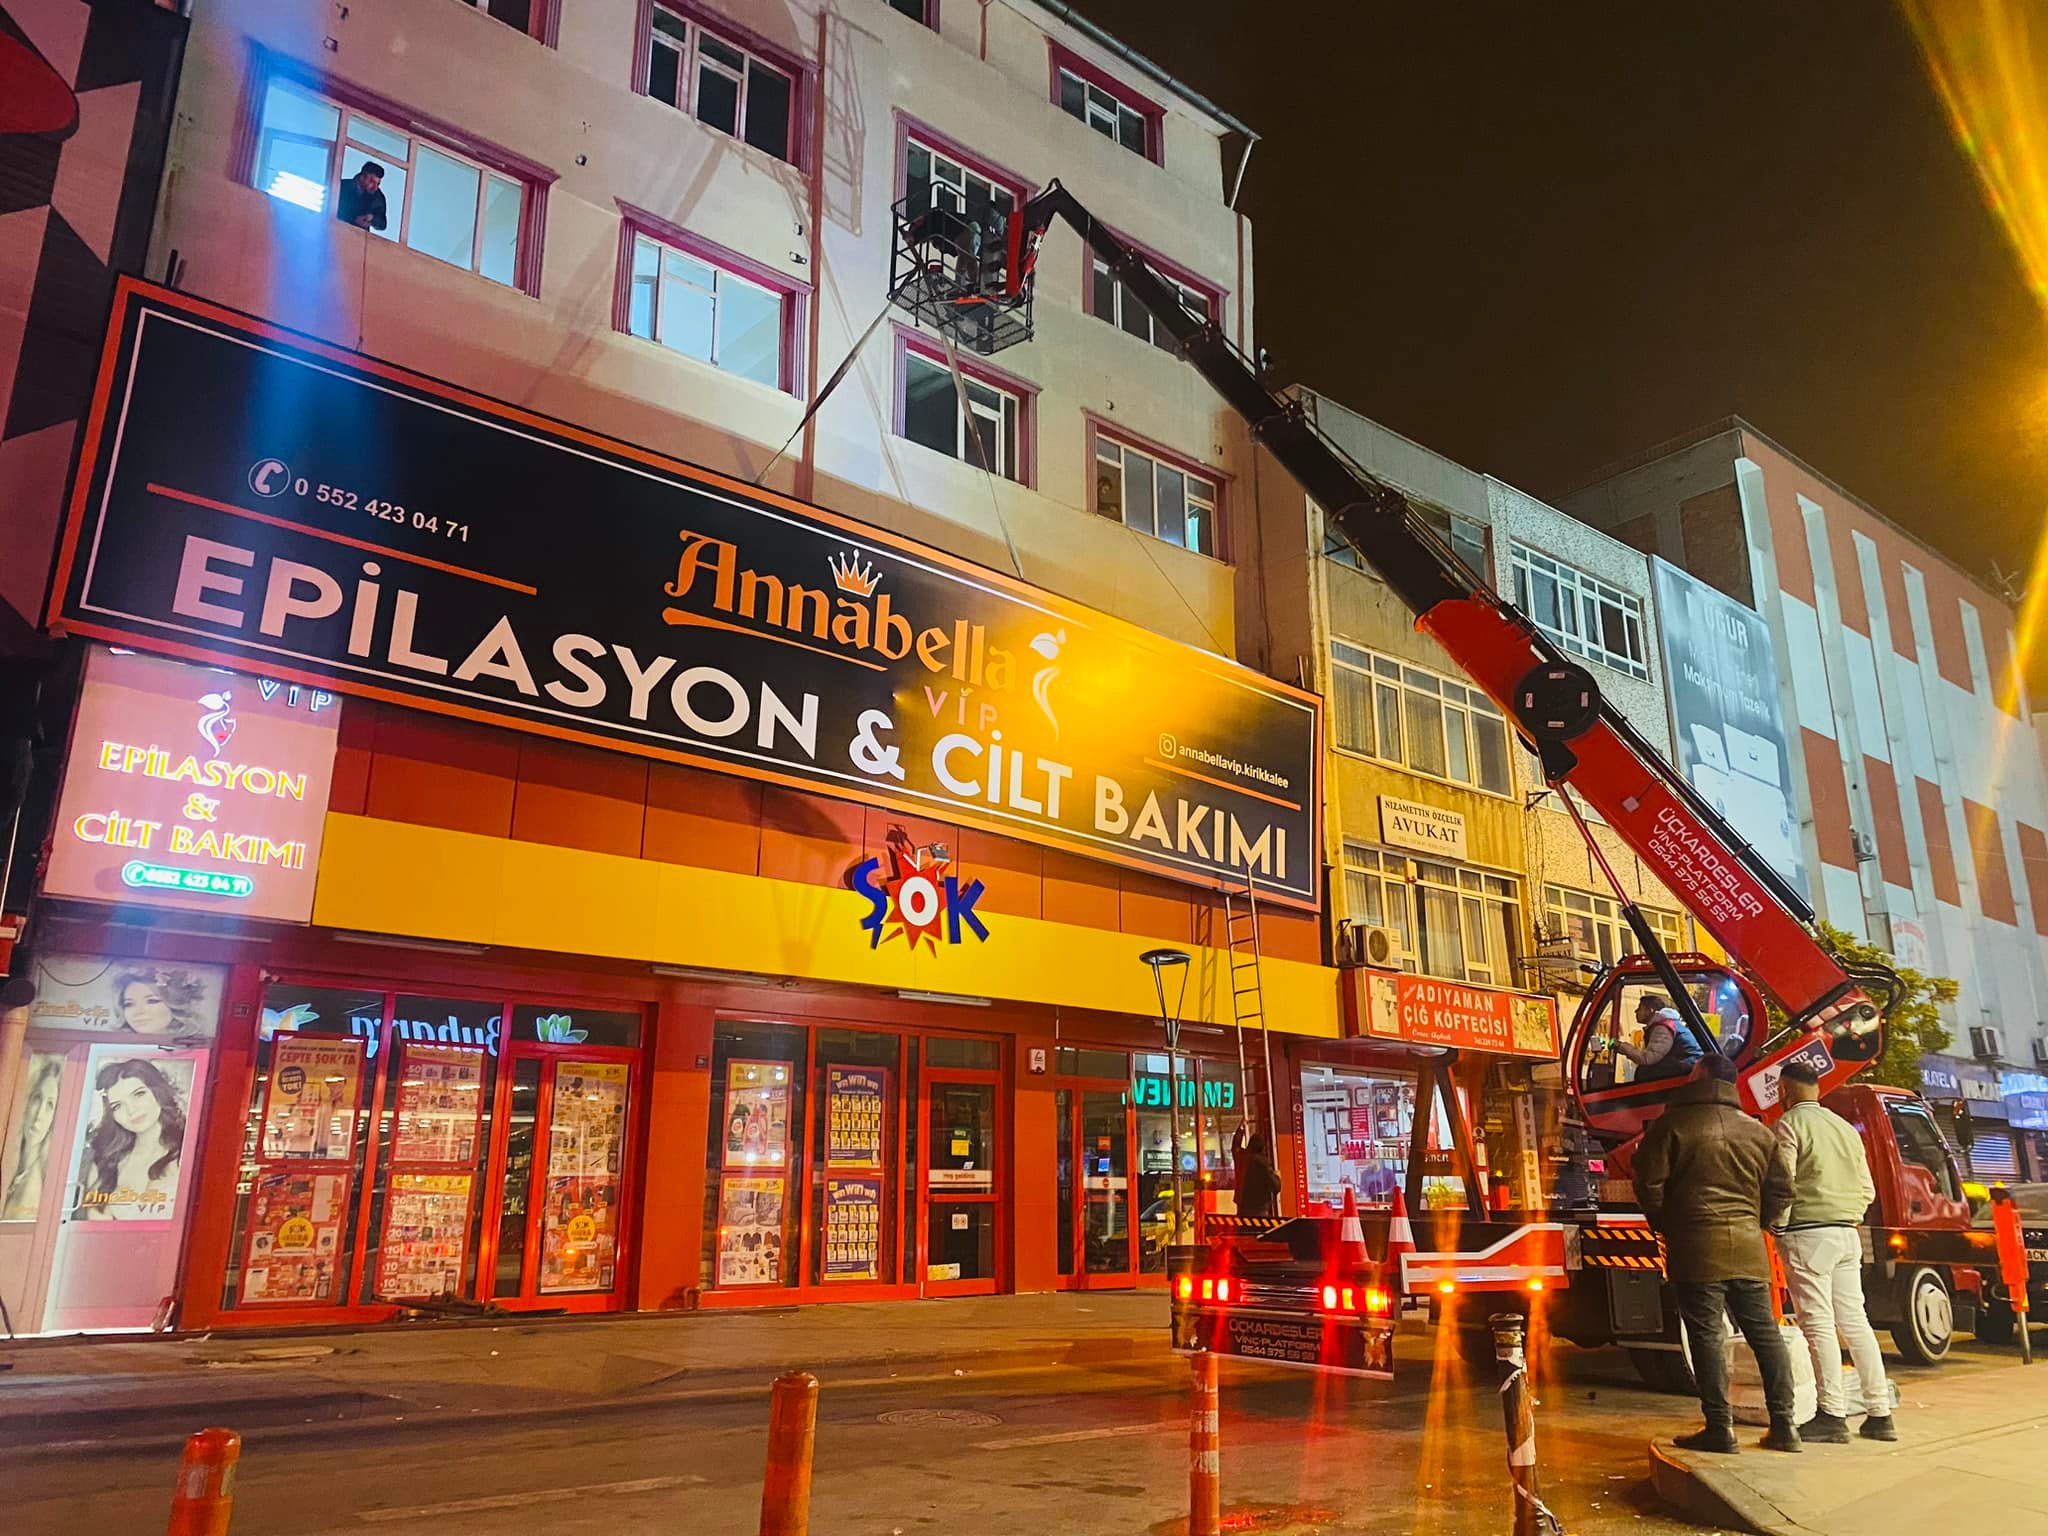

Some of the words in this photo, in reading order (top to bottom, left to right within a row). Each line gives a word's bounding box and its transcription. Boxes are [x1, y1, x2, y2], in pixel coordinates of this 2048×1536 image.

[294, 478, 309, 496] 0
[317, 484, 358, 511] 552
[364, 499, 405, 523] 423
[412, 512, 438, 533] 04
[445, 521, 469, 542] 71
[663, 530, 1017, 695] Annabella
[171, 534, 819, 759] EPİLASYON
[849, 709, 906, 781] &
[932, 729, 1073, 820] CİLT
[1094, 776, 1287, 880] BAKIMI
[98, 740, 307, 800] EPİLASYON
[183, 792, 220, 822] &
[1392, 815, 1458, 842] AVUKAT
[74, 811, 162, 849] CİLT
[169, 825, 306, 870] BAKIMI
[853, 857, 990, 950] ŞOK
[1648, 839, 1678, 870] 0544
[1675, 867, 1699, 891] 375
[1695, 889, 1713, 906] 56
[1710, 904, 1728, 922] 55
[1404, 1003, 1429, 1027] ÇİĞ
[1433, 1008, 1508, 1036] KÖFTECİSİ
[1416, 984, 1494, 1012] ADIYAMAN
